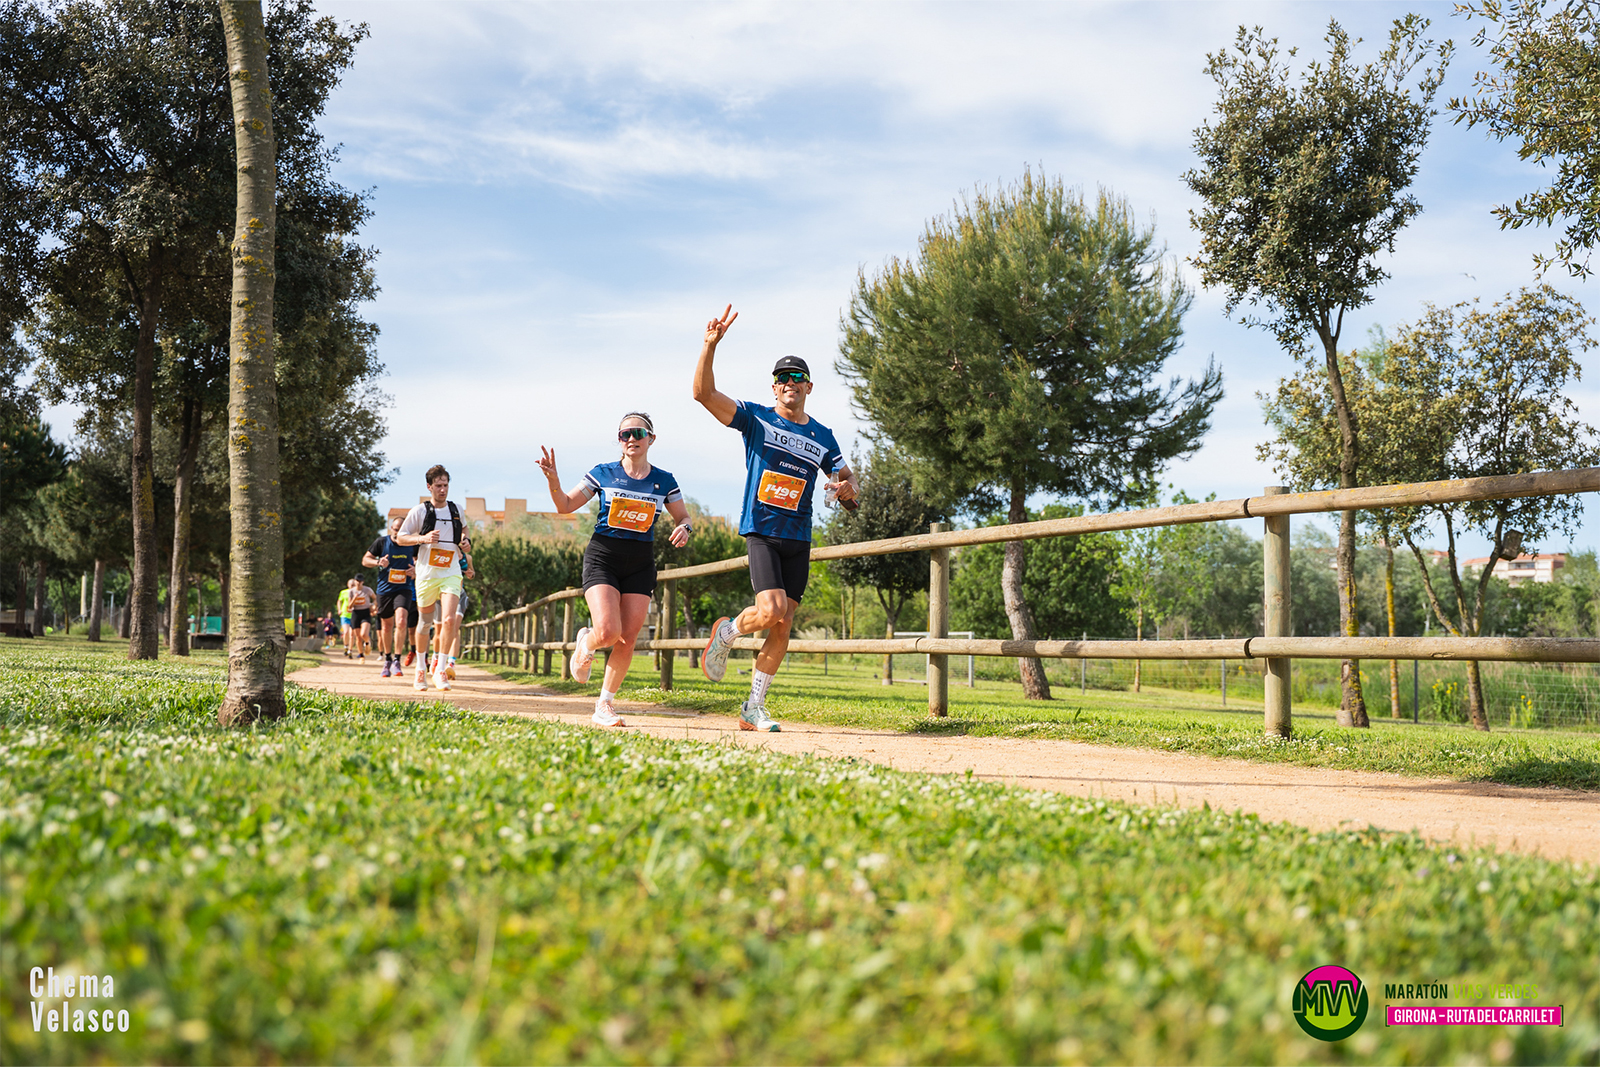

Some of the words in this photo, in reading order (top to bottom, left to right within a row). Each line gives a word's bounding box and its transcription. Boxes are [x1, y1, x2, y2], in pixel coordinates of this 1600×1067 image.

[779, 461, 800, 472] runner
[764, 483, 800, 499] 1496
[617, 510, 648, 521] 1168
